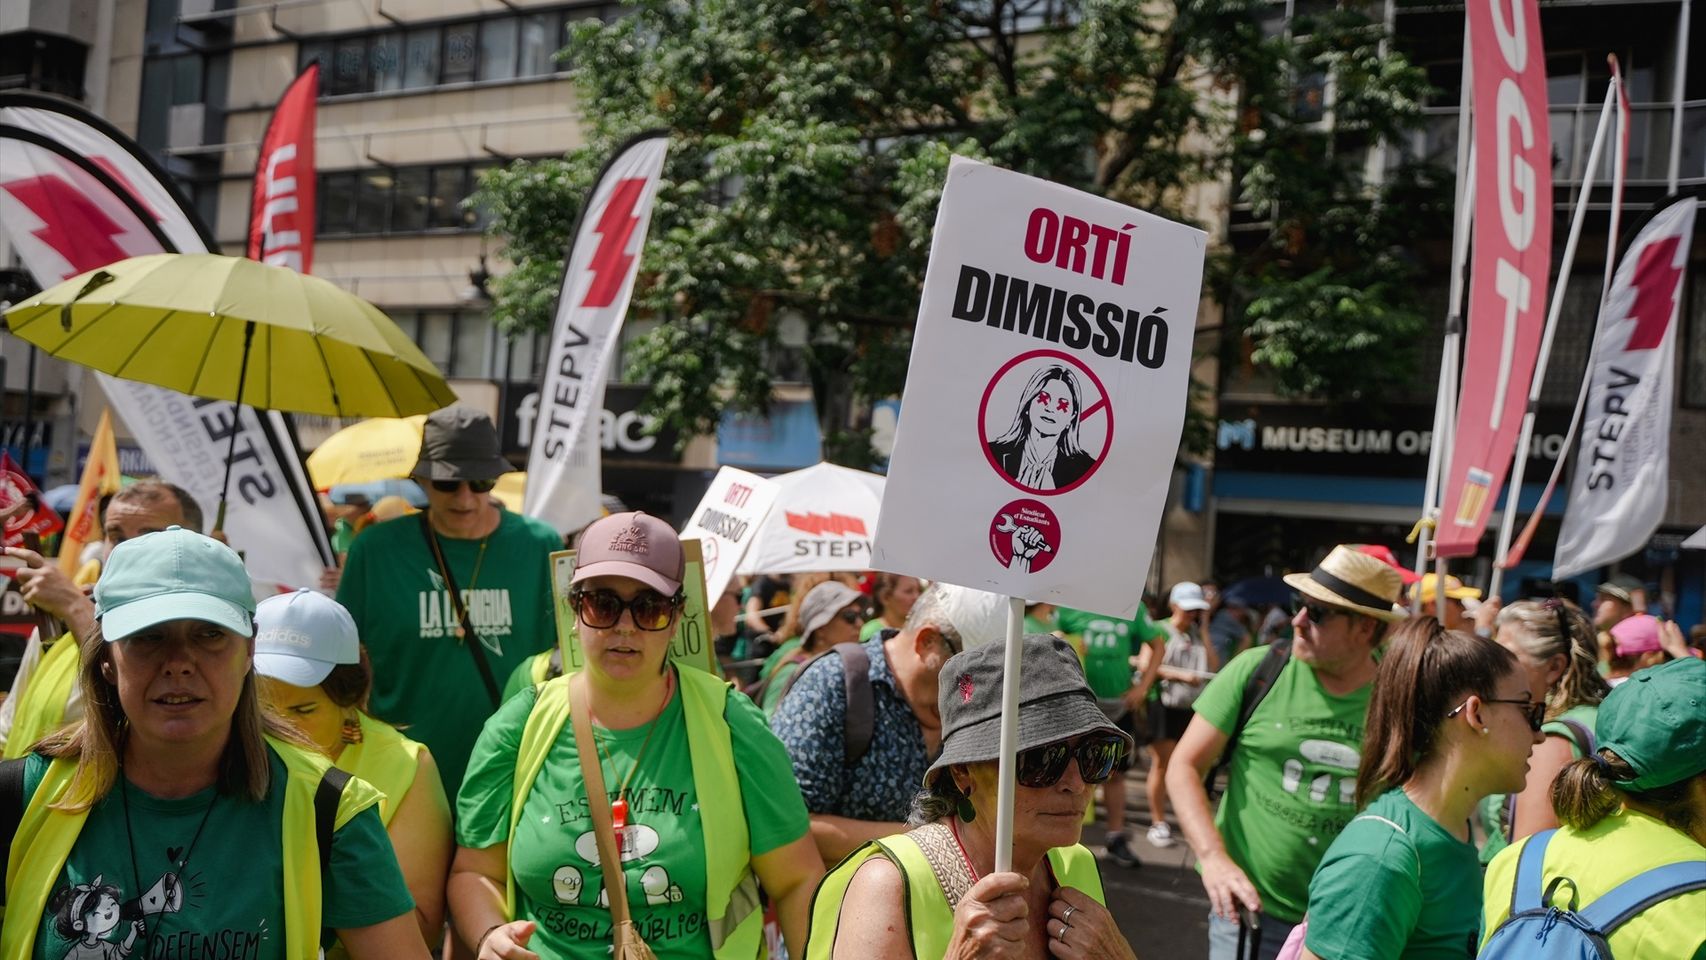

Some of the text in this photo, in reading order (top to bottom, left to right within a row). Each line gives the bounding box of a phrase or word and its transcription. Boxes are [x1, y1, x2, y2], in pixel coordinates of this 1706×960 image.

[1024, 207, 1137, 286] ORTÍ
[952, 264, 1169, 370] DIMISSIÓ
[544, 323, 590, 460] STEPV
[516, 392, 657, 452] fac
[1262, 426, 1392, 454] MUSEUM
[1587, 366, 1641, 491] STEPV
[1021, 507, 1046, 518] Sindicat
[419, 588, 443, 628] LA
[419, 628, 444, 638] NO
[152, 929, 261, 960] DEFENSEM
